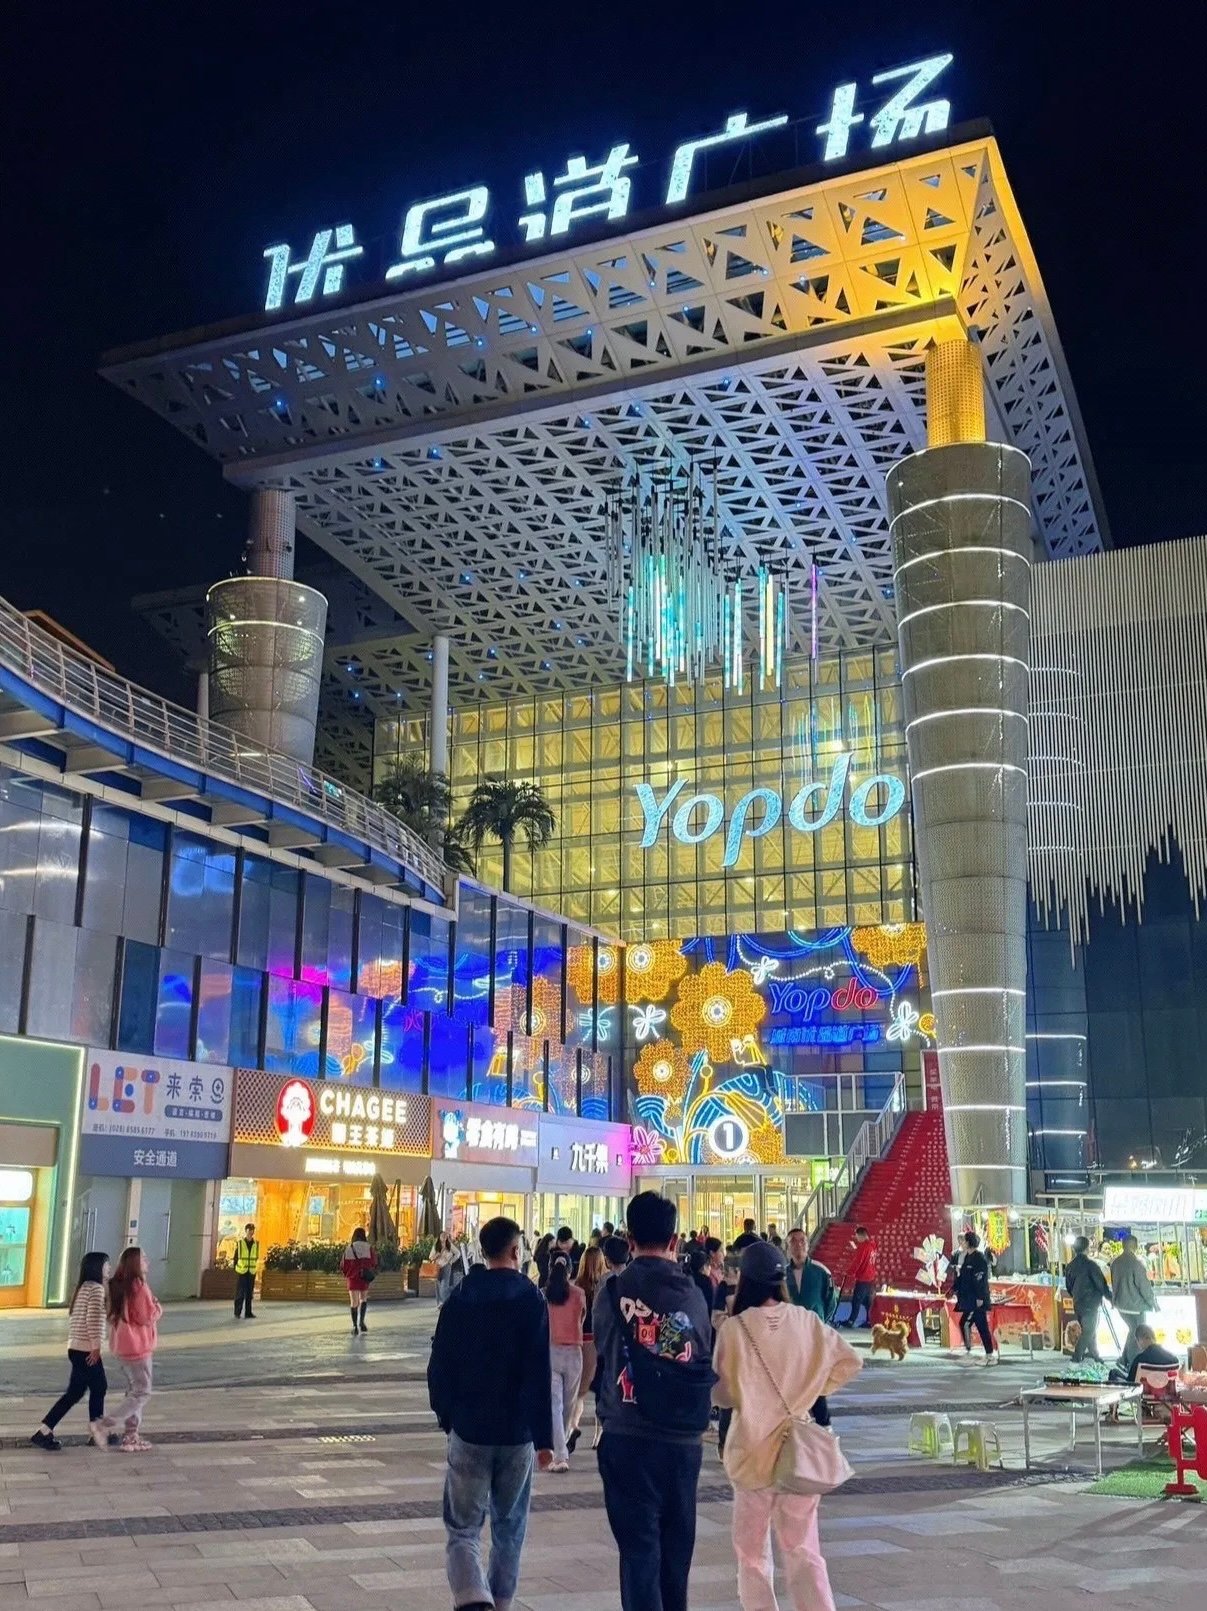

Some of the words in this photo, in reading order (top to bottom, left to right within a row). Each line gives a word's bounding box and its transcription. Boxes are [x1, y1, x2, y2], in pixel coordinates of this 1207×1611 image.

[264, 53, 954, 312] 优品道广场
[633, 752, 905, 867] Yopdo
[769, 976, 879, 1022] Yopdo
[166, 1072, 204, 1103] 来索
[319, 1089, 408, 1123] CHAGEE
[331, 1121, 395, 1148] 王茶
[723, 1123, 734, 1150] 1
[133, 1149, 178, 1167] 安全通道
